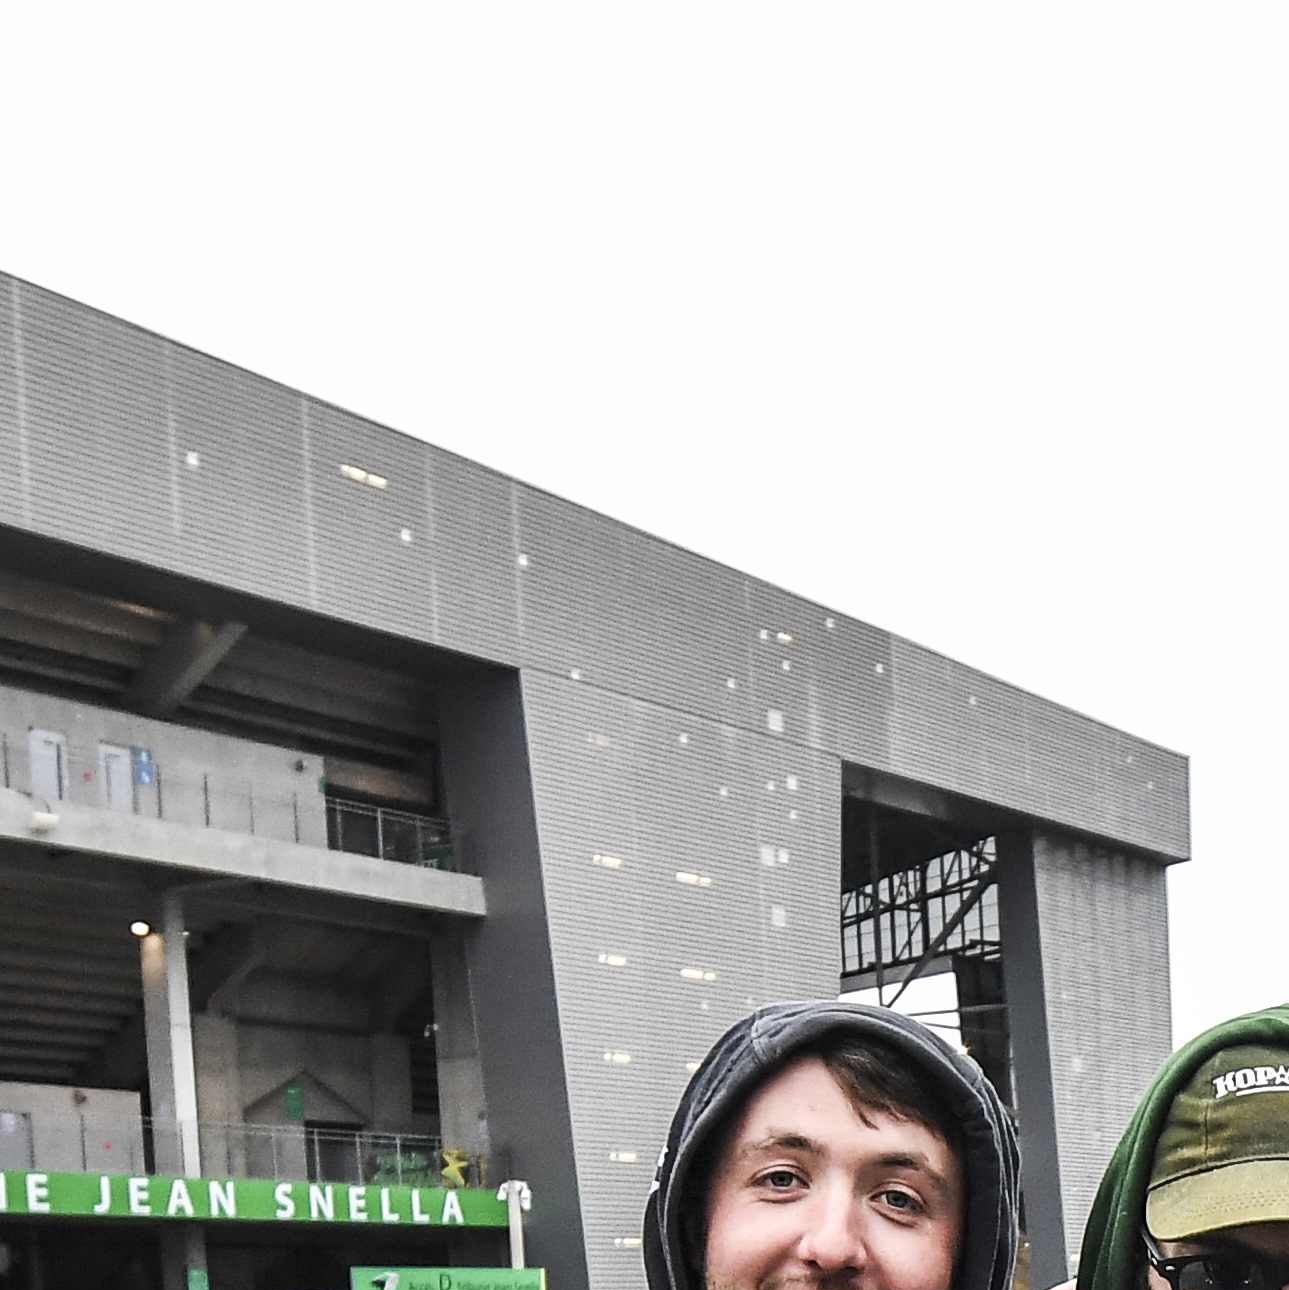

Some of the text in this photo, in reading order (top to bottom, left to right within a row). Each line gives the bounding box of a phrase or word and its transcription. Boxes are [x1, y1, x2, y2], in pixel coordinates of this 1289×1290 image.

[0, 1172, 464, 1224] E JEAN SNELLA
